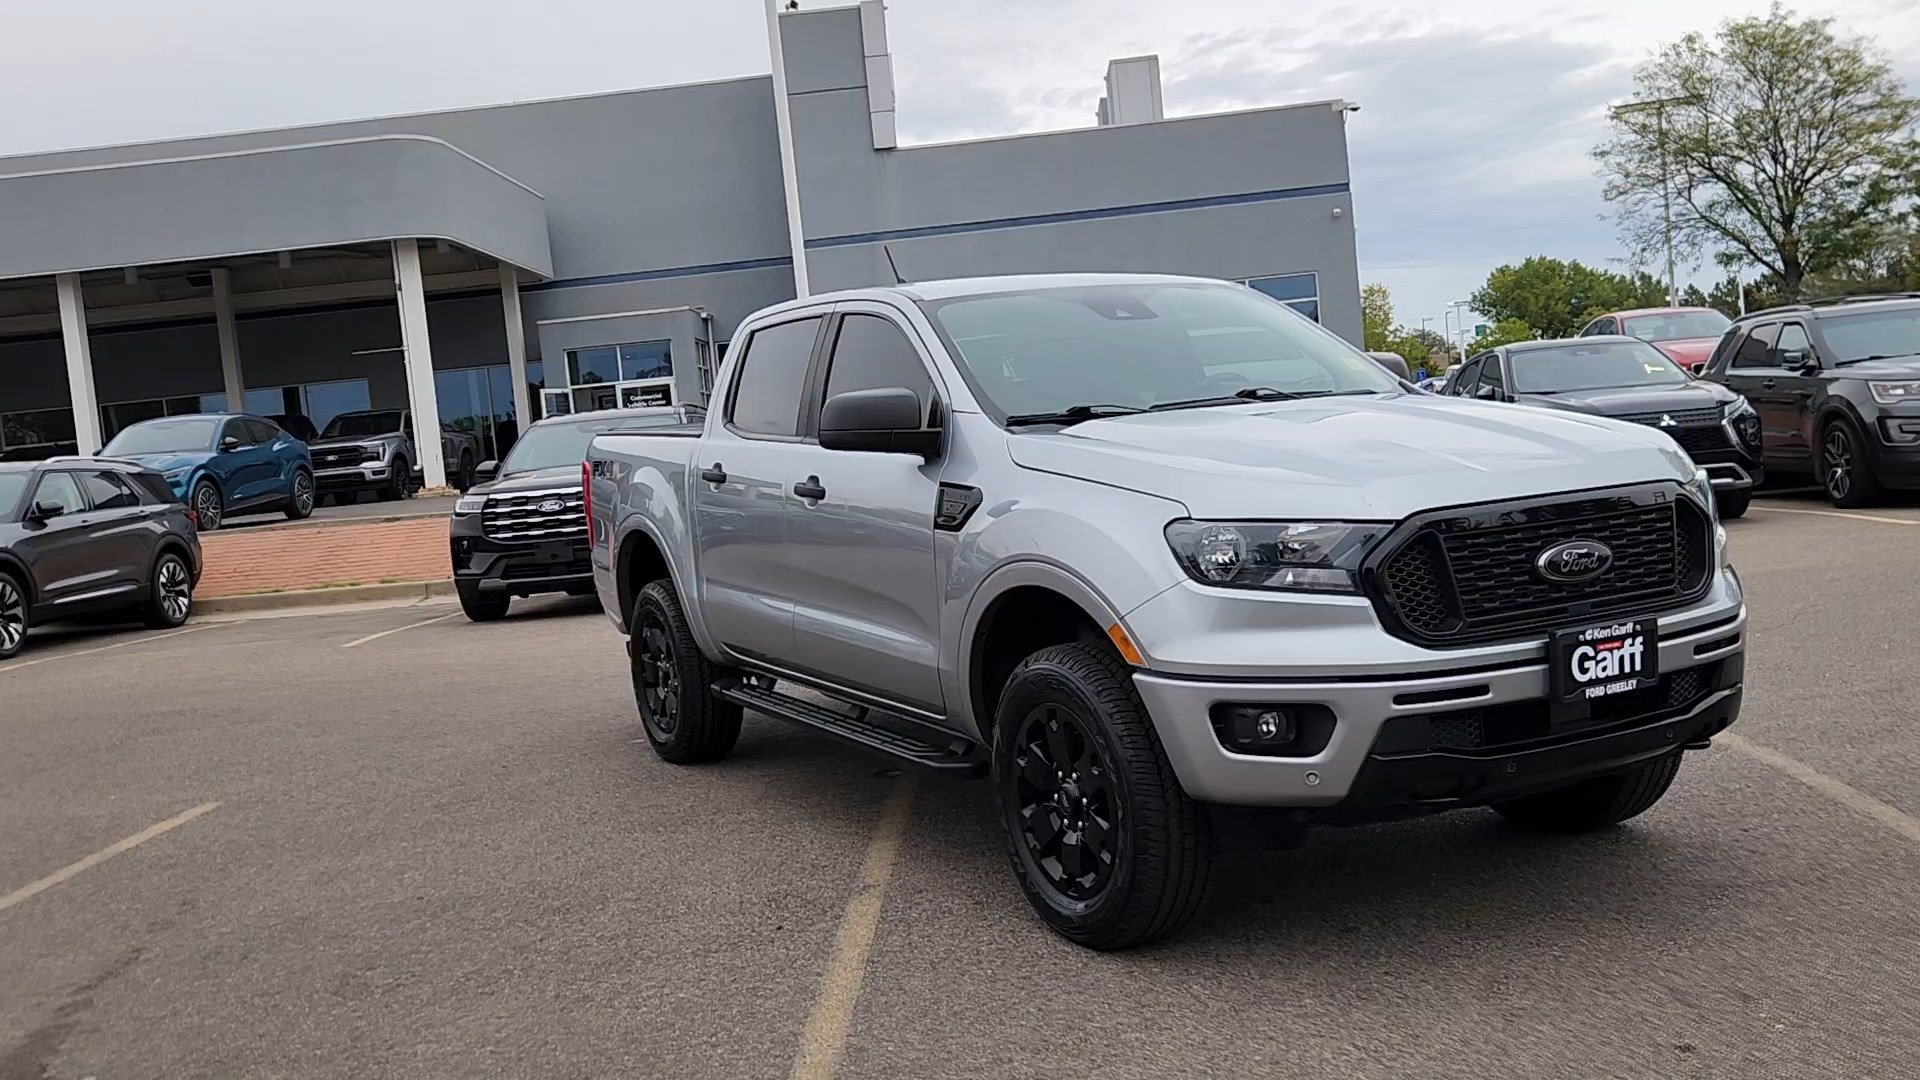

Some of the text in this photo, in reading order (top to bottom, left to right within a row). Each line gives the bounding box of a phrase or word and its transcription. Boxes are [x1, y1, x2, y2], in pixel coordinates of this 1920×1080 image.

[592, 460, 614, 480] FX4
[1560, 548, 1600, 573] Ford
[1593, 622, 1634, 639] Ken Garff
[1571, 636, 1644, 682] Garff
[1585, 679, 1638, 699] FORD GREELEY
